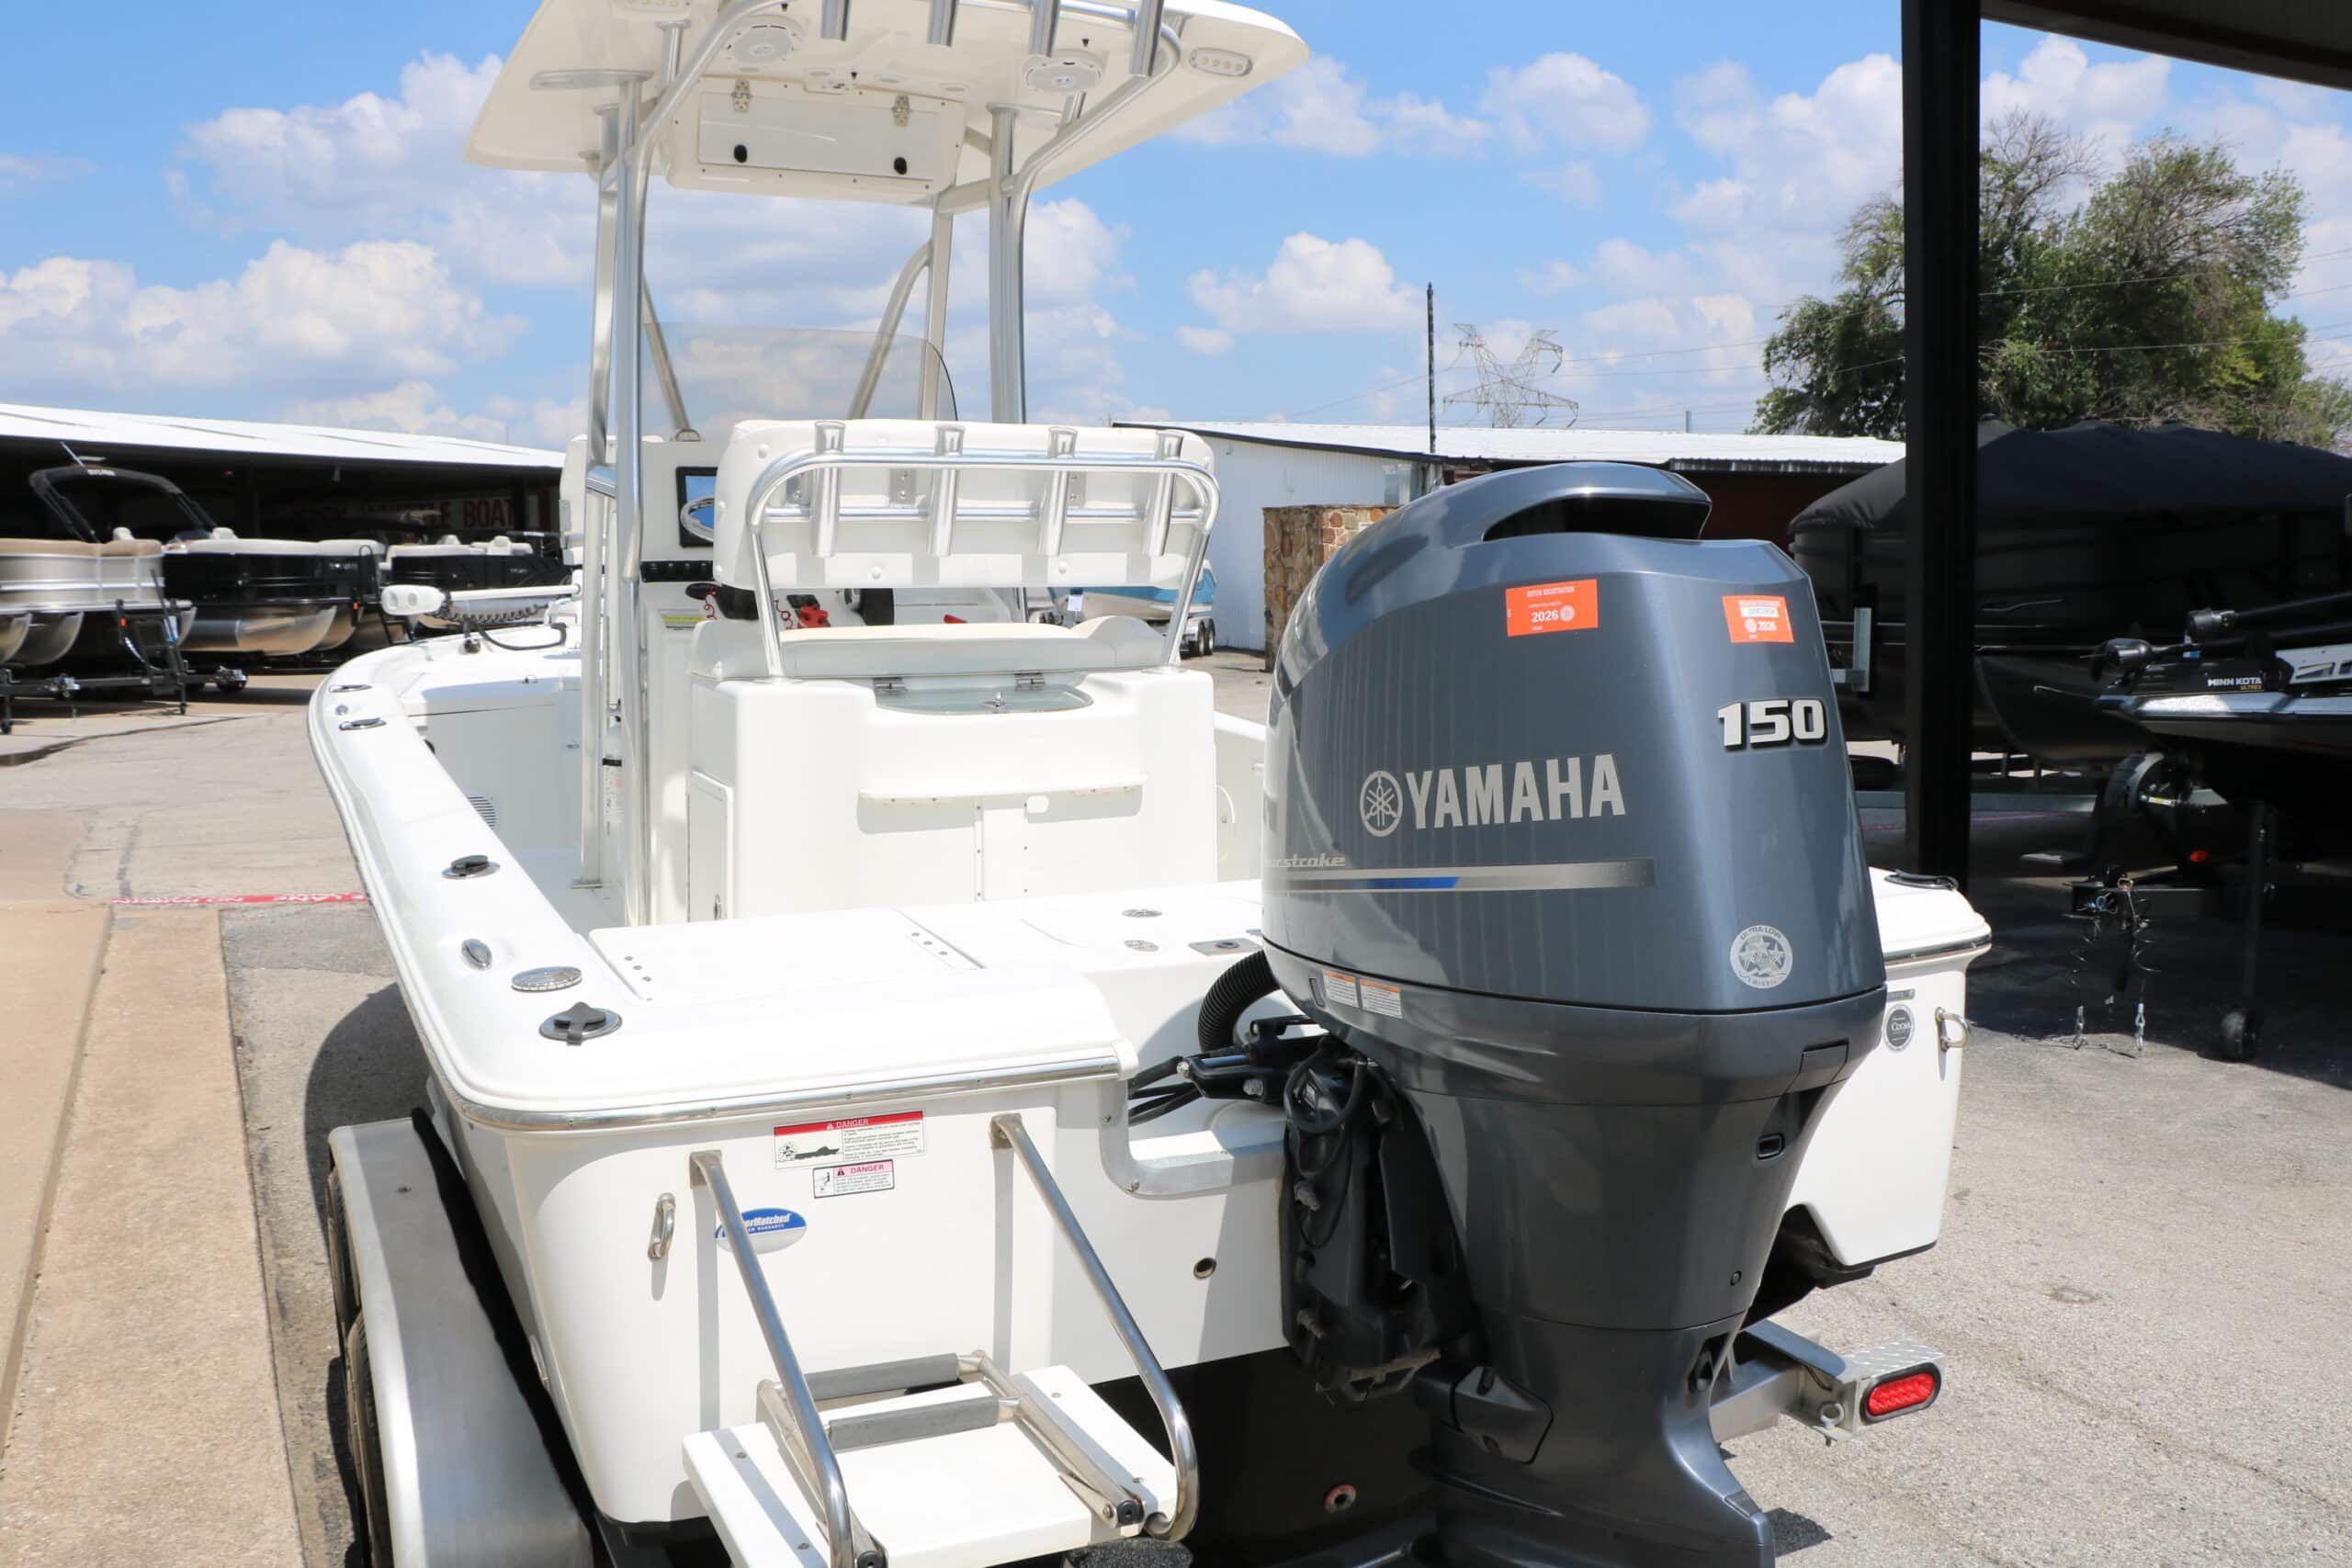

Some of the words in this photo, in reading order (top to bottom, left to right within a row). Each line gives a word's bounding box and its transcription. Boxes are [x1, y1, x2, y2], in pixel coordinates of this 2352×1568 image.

[1532, 609, 1559, 623] 2026
[2207, 678, 2234, 687] MINN
[2235, 676, 2262, 685] KOTA
[1717, 699, 1826, 748] 150
[1405, 753, 1626, 829] YAMAHA
[836, 1118, 868, 1129] DANGER
[851, 1164, 885, 1174] DANGER
